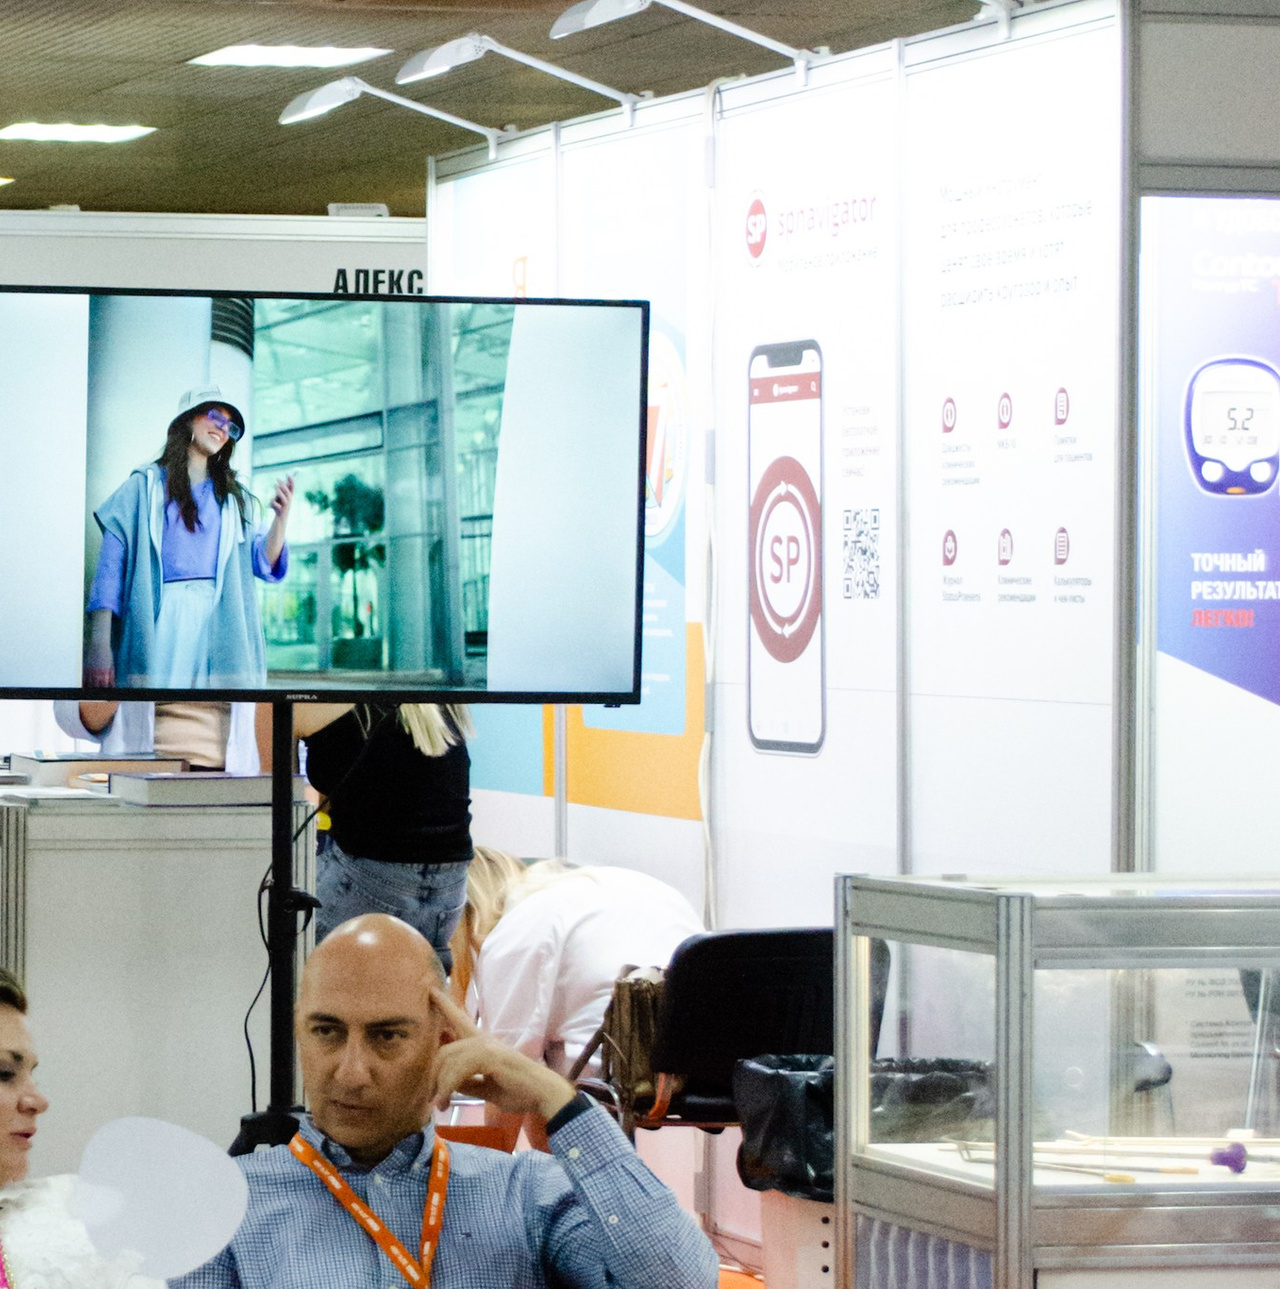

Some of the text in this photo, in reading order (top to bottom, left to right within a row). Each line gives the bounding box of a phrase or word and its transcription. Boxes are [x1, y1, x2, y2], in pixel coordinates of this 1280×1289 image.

[777, 194, 878, 245] spnavigator
[1227, 407, 1255, 431] 5.2
[770, 535, 801, 584] SP
[1191, 548, 1266, 573] ТОЧНЫЙ
[1191, 609, 1254, 628] ЛЕГКО!
